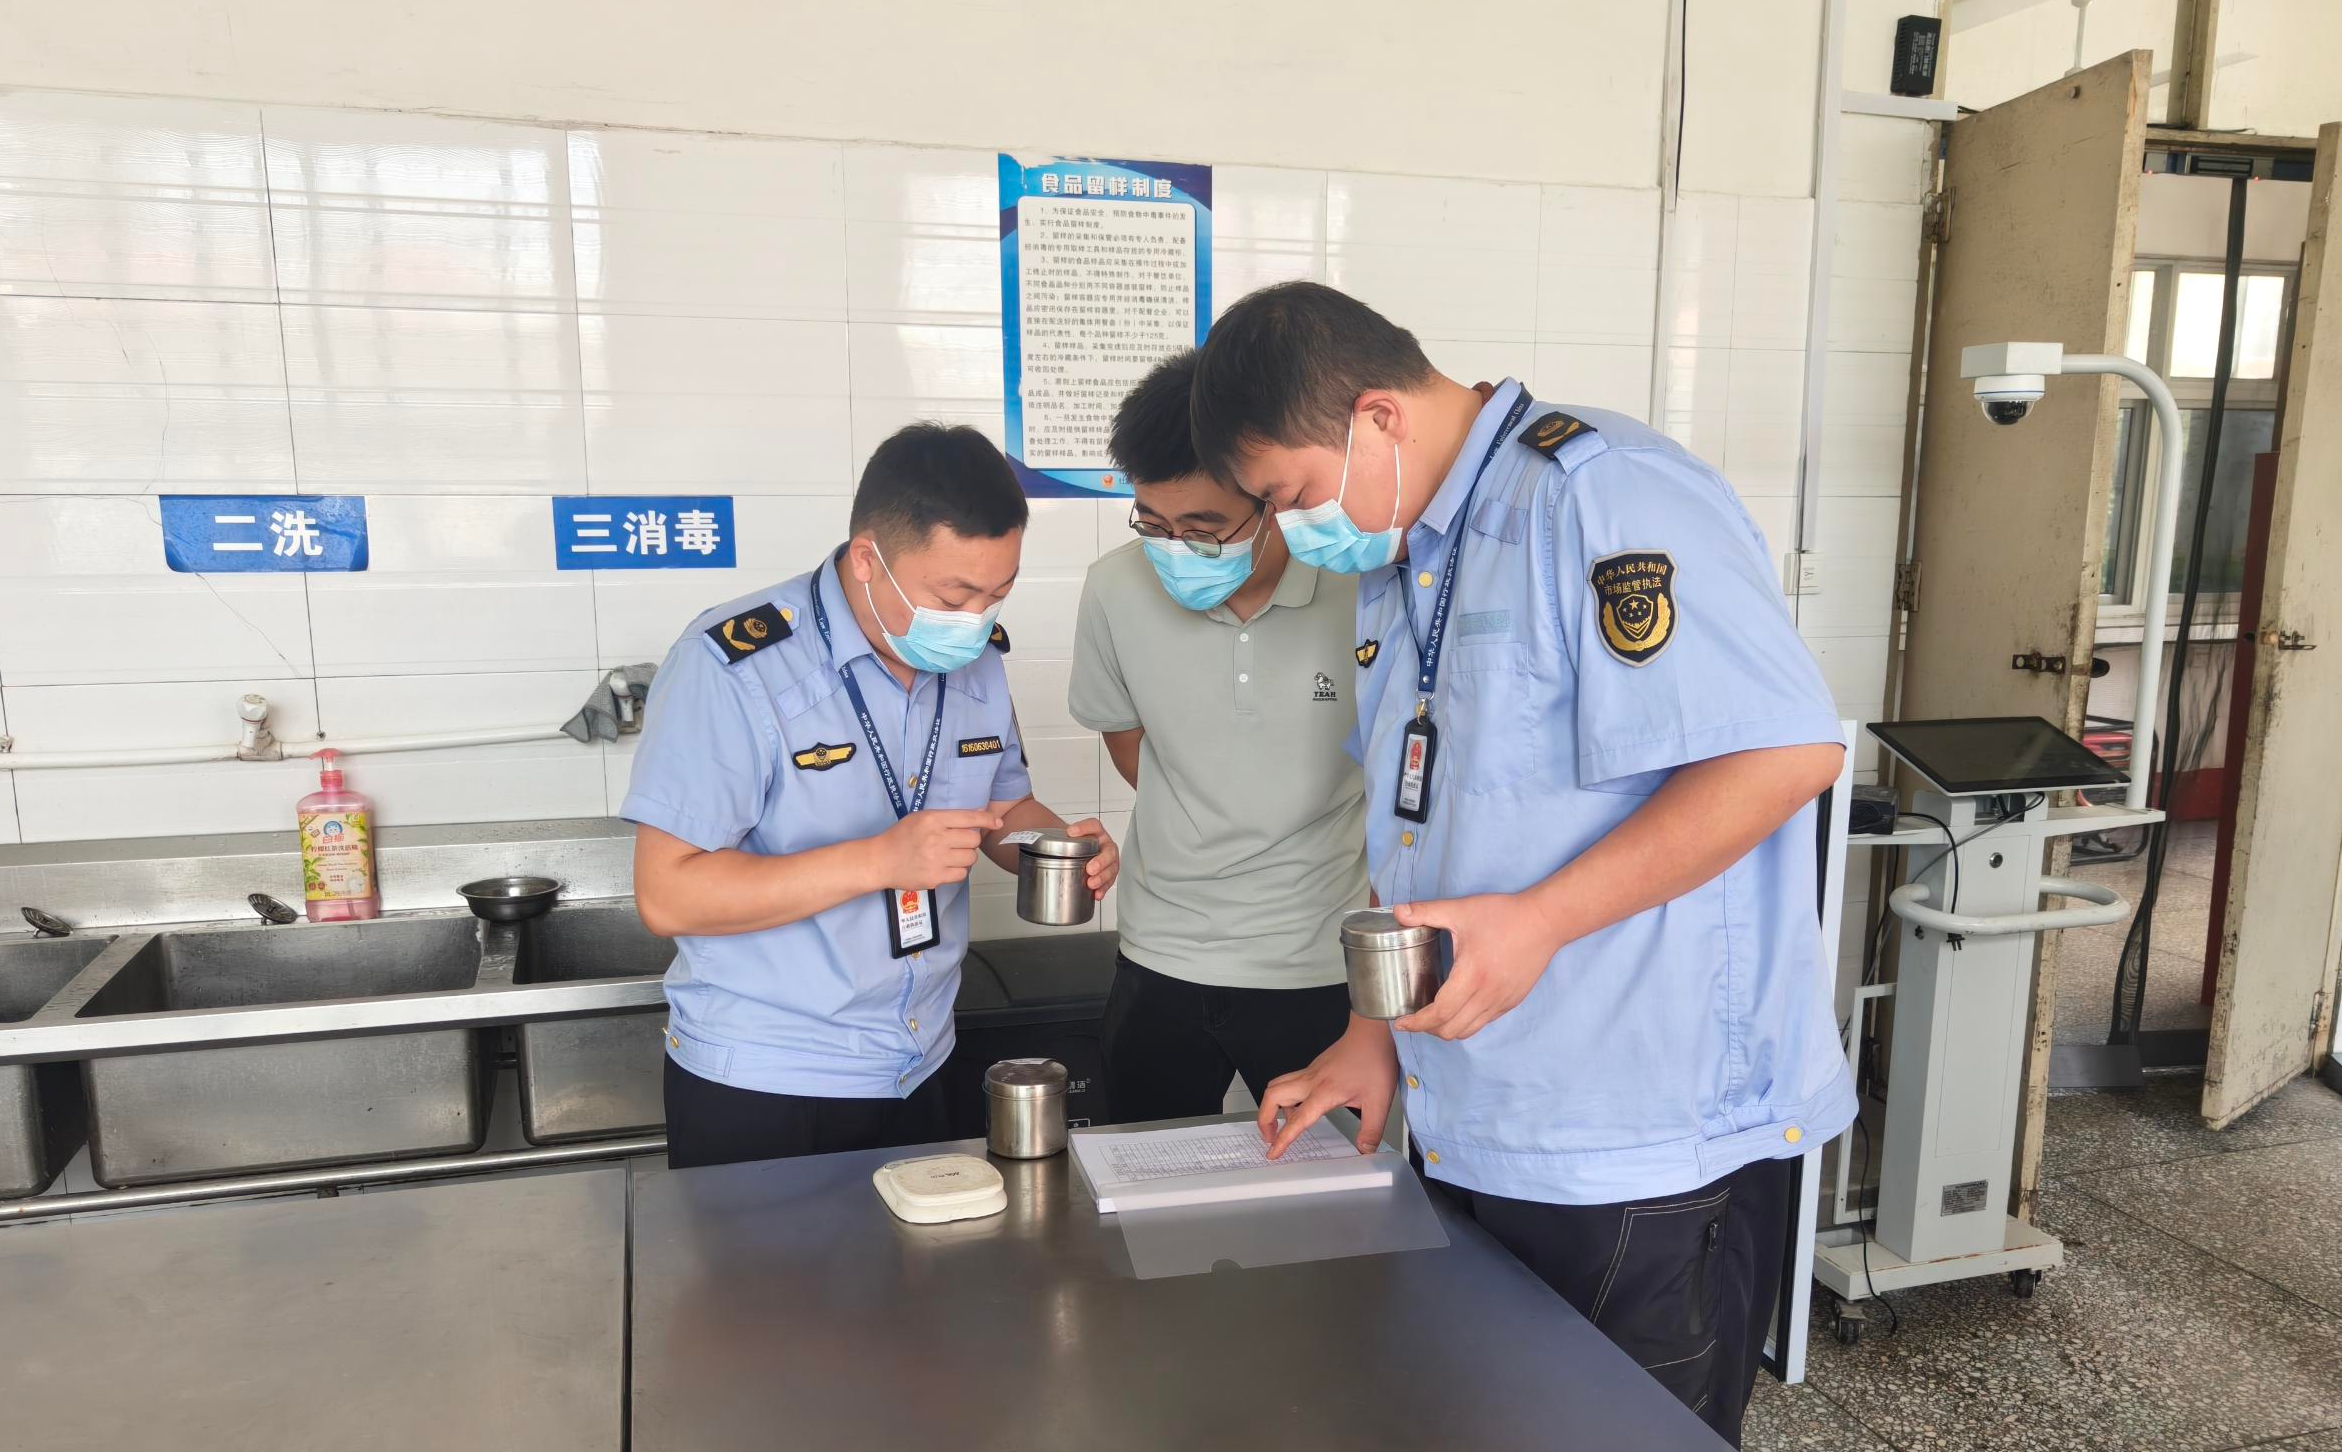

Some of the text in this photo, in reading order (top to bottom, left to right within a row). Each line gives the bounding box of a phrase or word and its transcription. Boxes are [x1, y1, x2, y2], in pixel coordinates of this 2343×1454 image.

[1042, 173, 1172, 198] 食品留样制度
[212, 510, 323, 556] 二洗
[571, 509, 721, 556] 三消毒
[1597, 561, 1667, 585] 中华人民共和国
[1604, 576, 1661, 596] 市场监管执法
